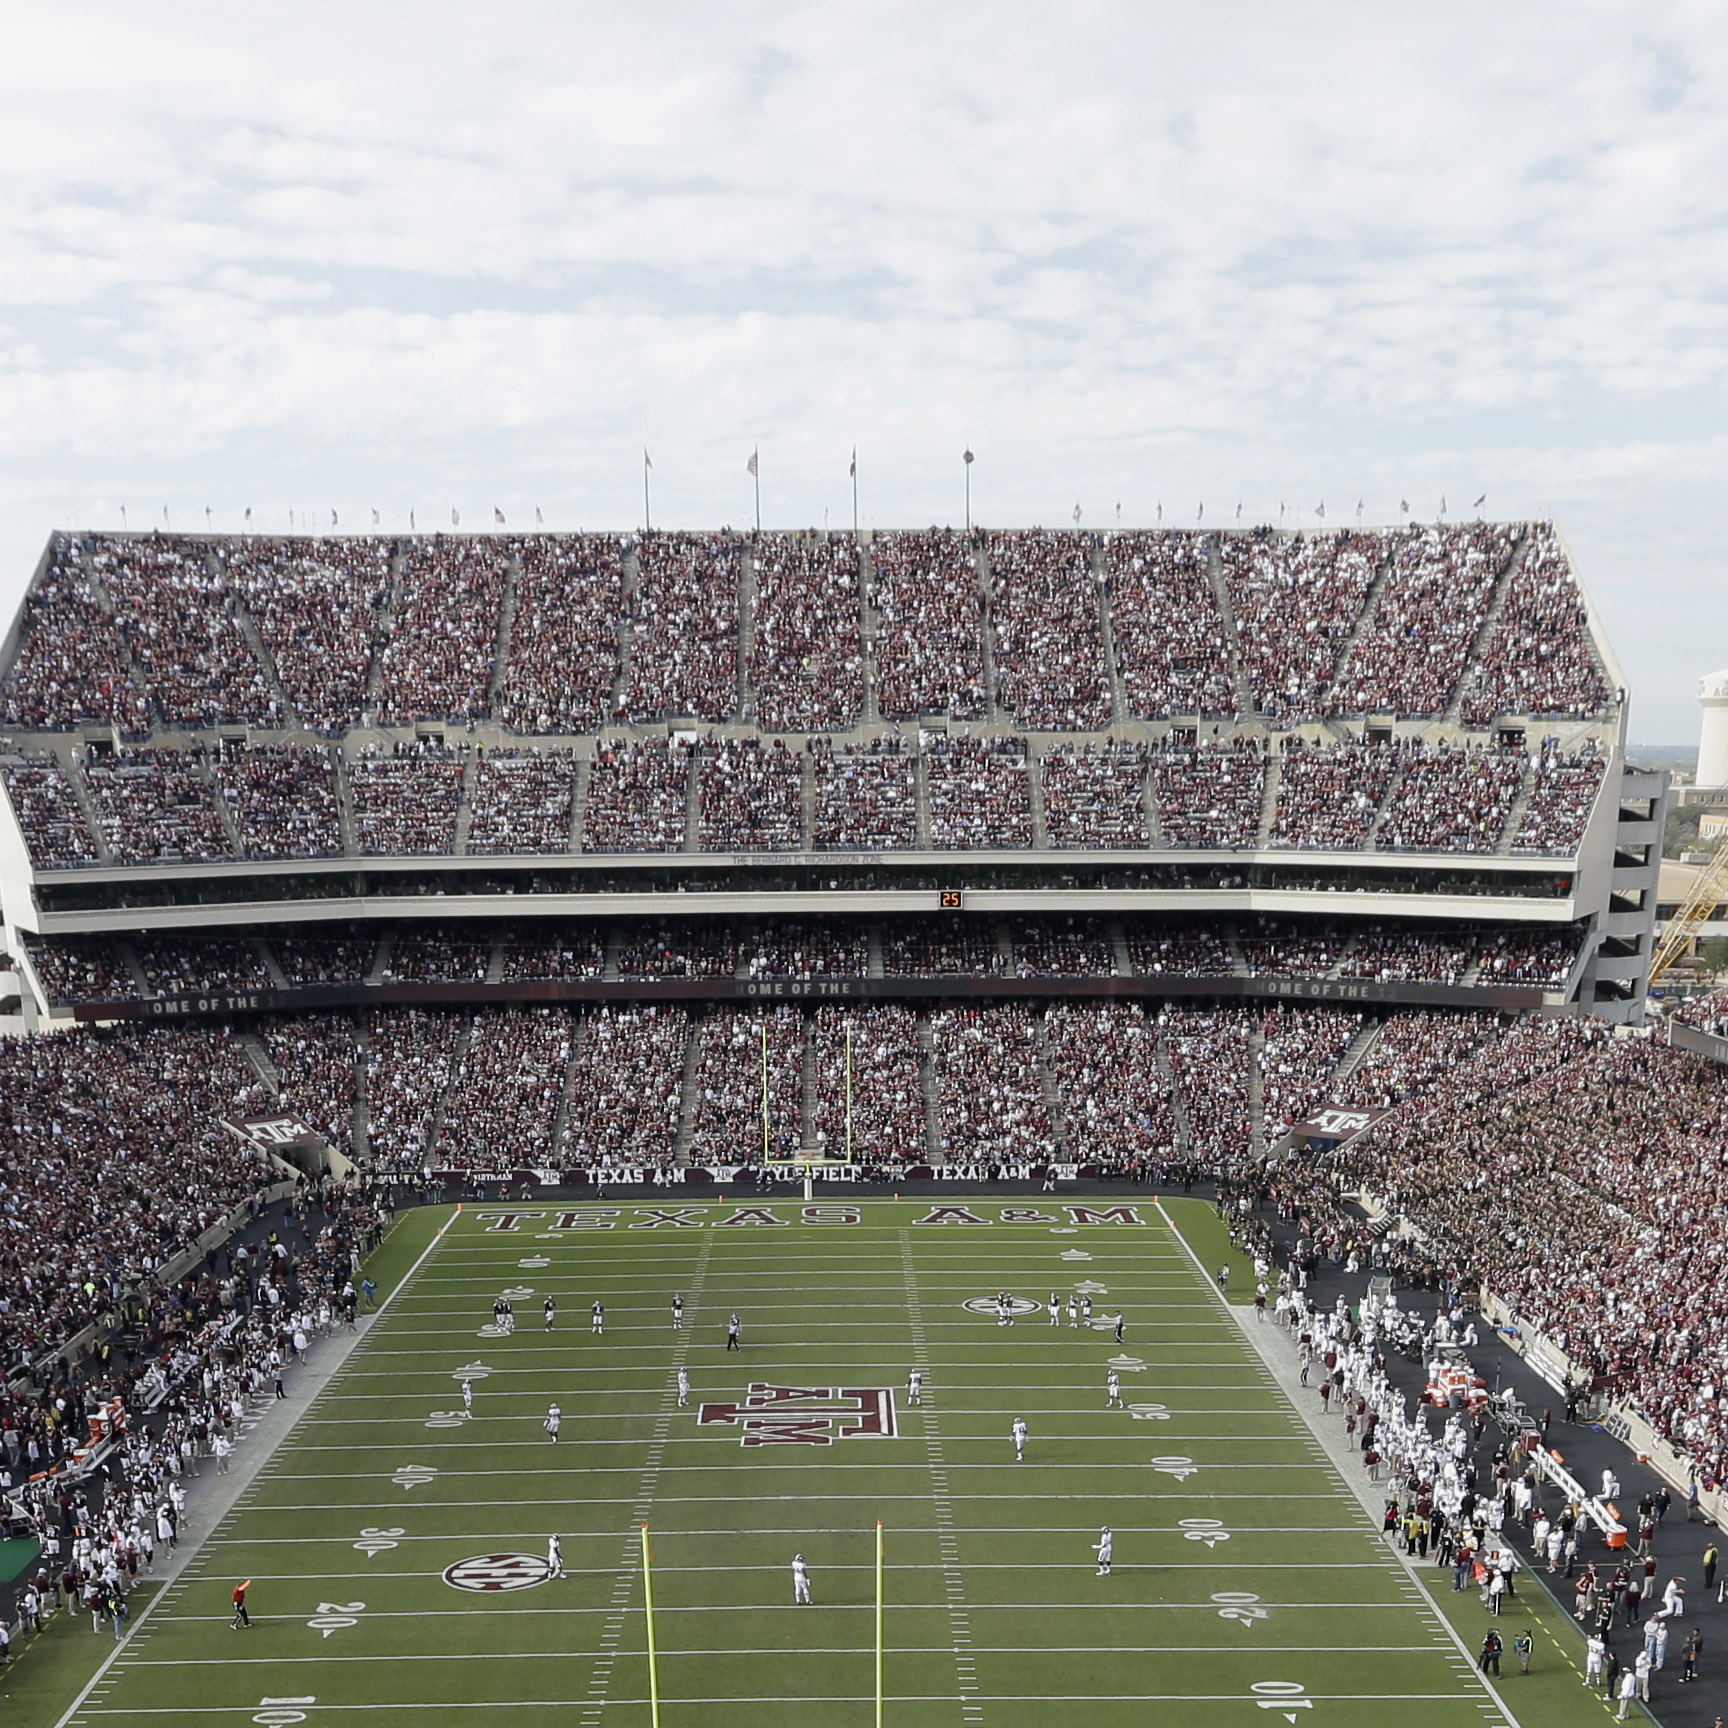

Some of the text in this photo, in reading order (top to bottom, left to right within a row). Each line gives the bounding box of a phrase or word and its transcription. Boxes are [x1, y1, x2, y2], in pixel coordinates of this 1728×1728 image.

[943, 894, 959, 906] 25
[791, 983, 812, 995] OF
[820, 983, 850, 994] THE
[1311, 984, 1330, 996] OF
[1338, 985, 1369, 998] THE
[199, 999, 219, 1011] OF
[227, 996, 258, 1009] THE
[585, 1168, 686, 1184] TEXAS AM
[771, 1166, 805, 1181] YLE
[931, 1164, 1030, 1180] TEXA A&M
[476, 1206, 1146, 1232] TEXAS A&M
[353, 1527, 406, 1550] 30
[1177, 1518, 1231, 1541] 30
[306, 1602, 366, 1628] 20
[1210, 1591, 1270, 1621] 20
[1250, 1681, 1313, 1709] 10
[252, 1696, 316, 1724] 10
